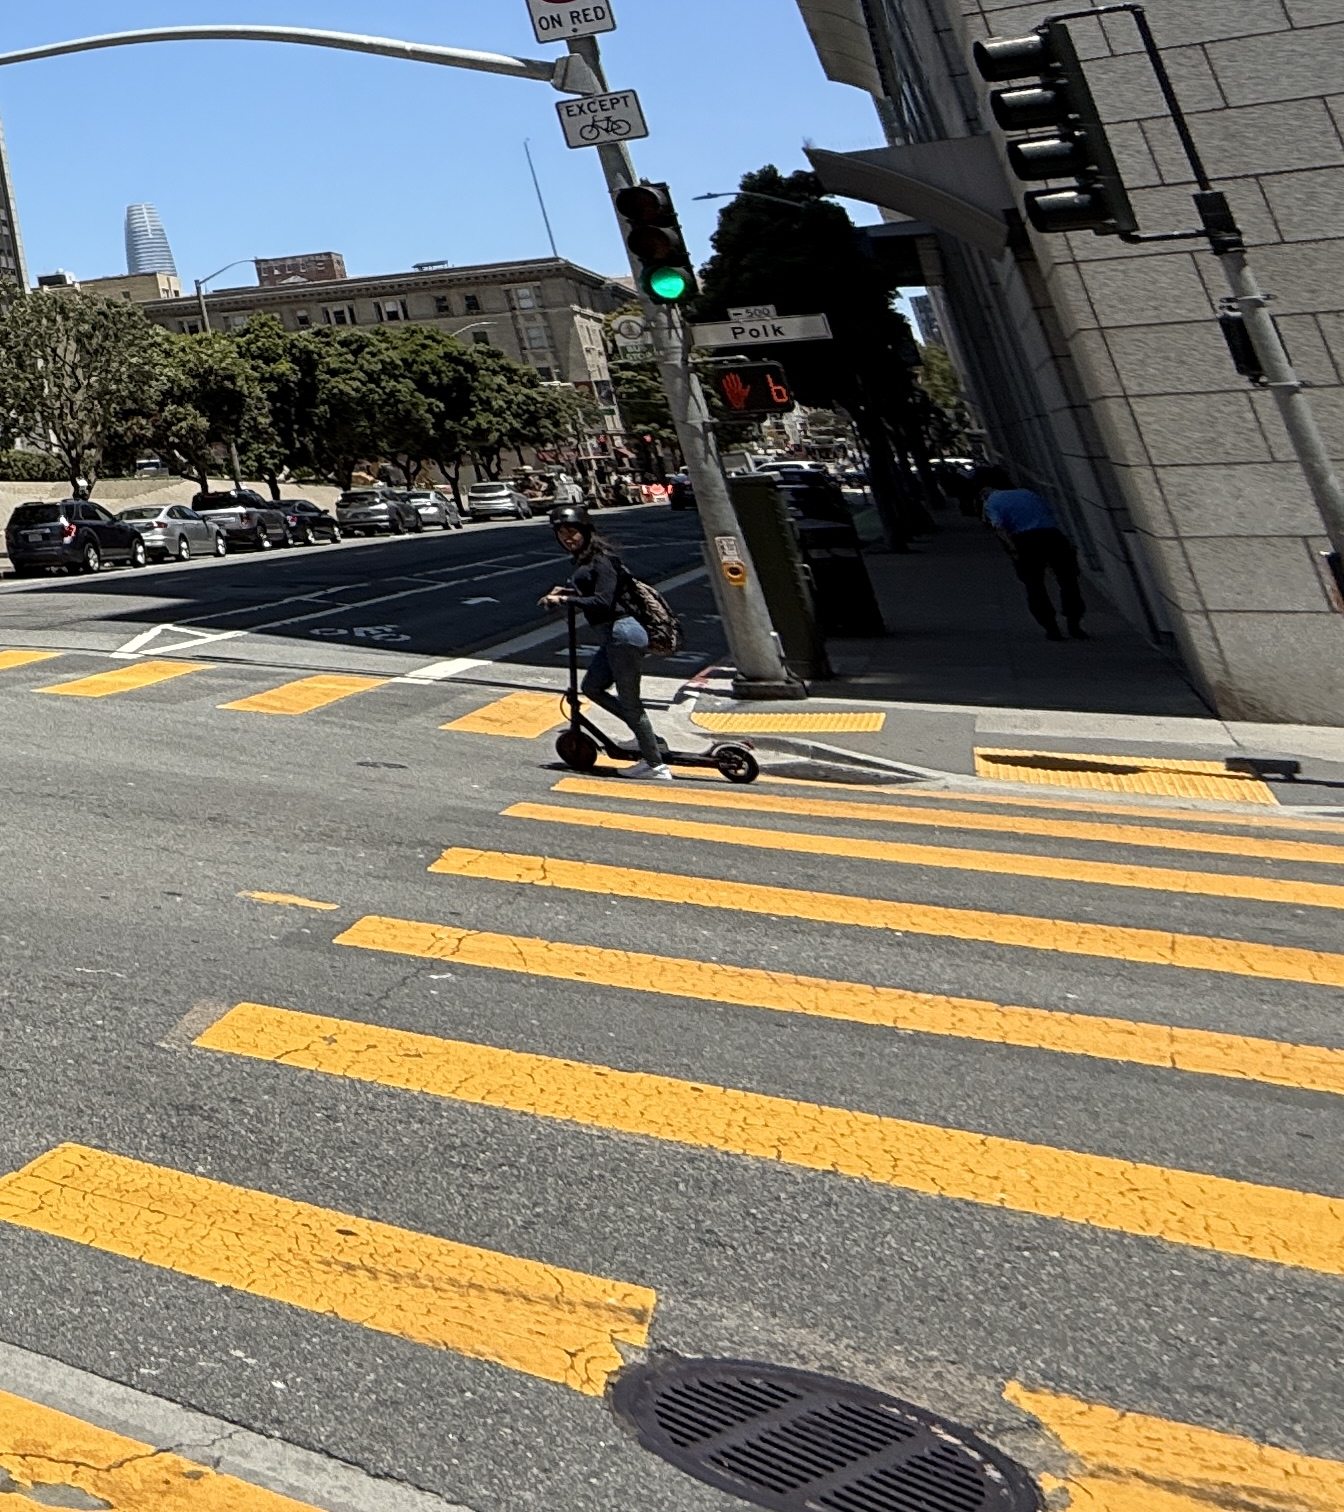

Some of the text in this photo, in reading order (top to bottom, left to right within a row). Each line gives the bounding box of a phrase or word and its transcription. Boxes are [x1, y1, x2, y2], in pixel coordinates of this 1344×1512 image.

[538, 5, 606, 32] ON RED
[566, 95, 630, 119] EXCEPT
[745, 307, 771, 318] 500
[731, 324, 785, 340] Polk
